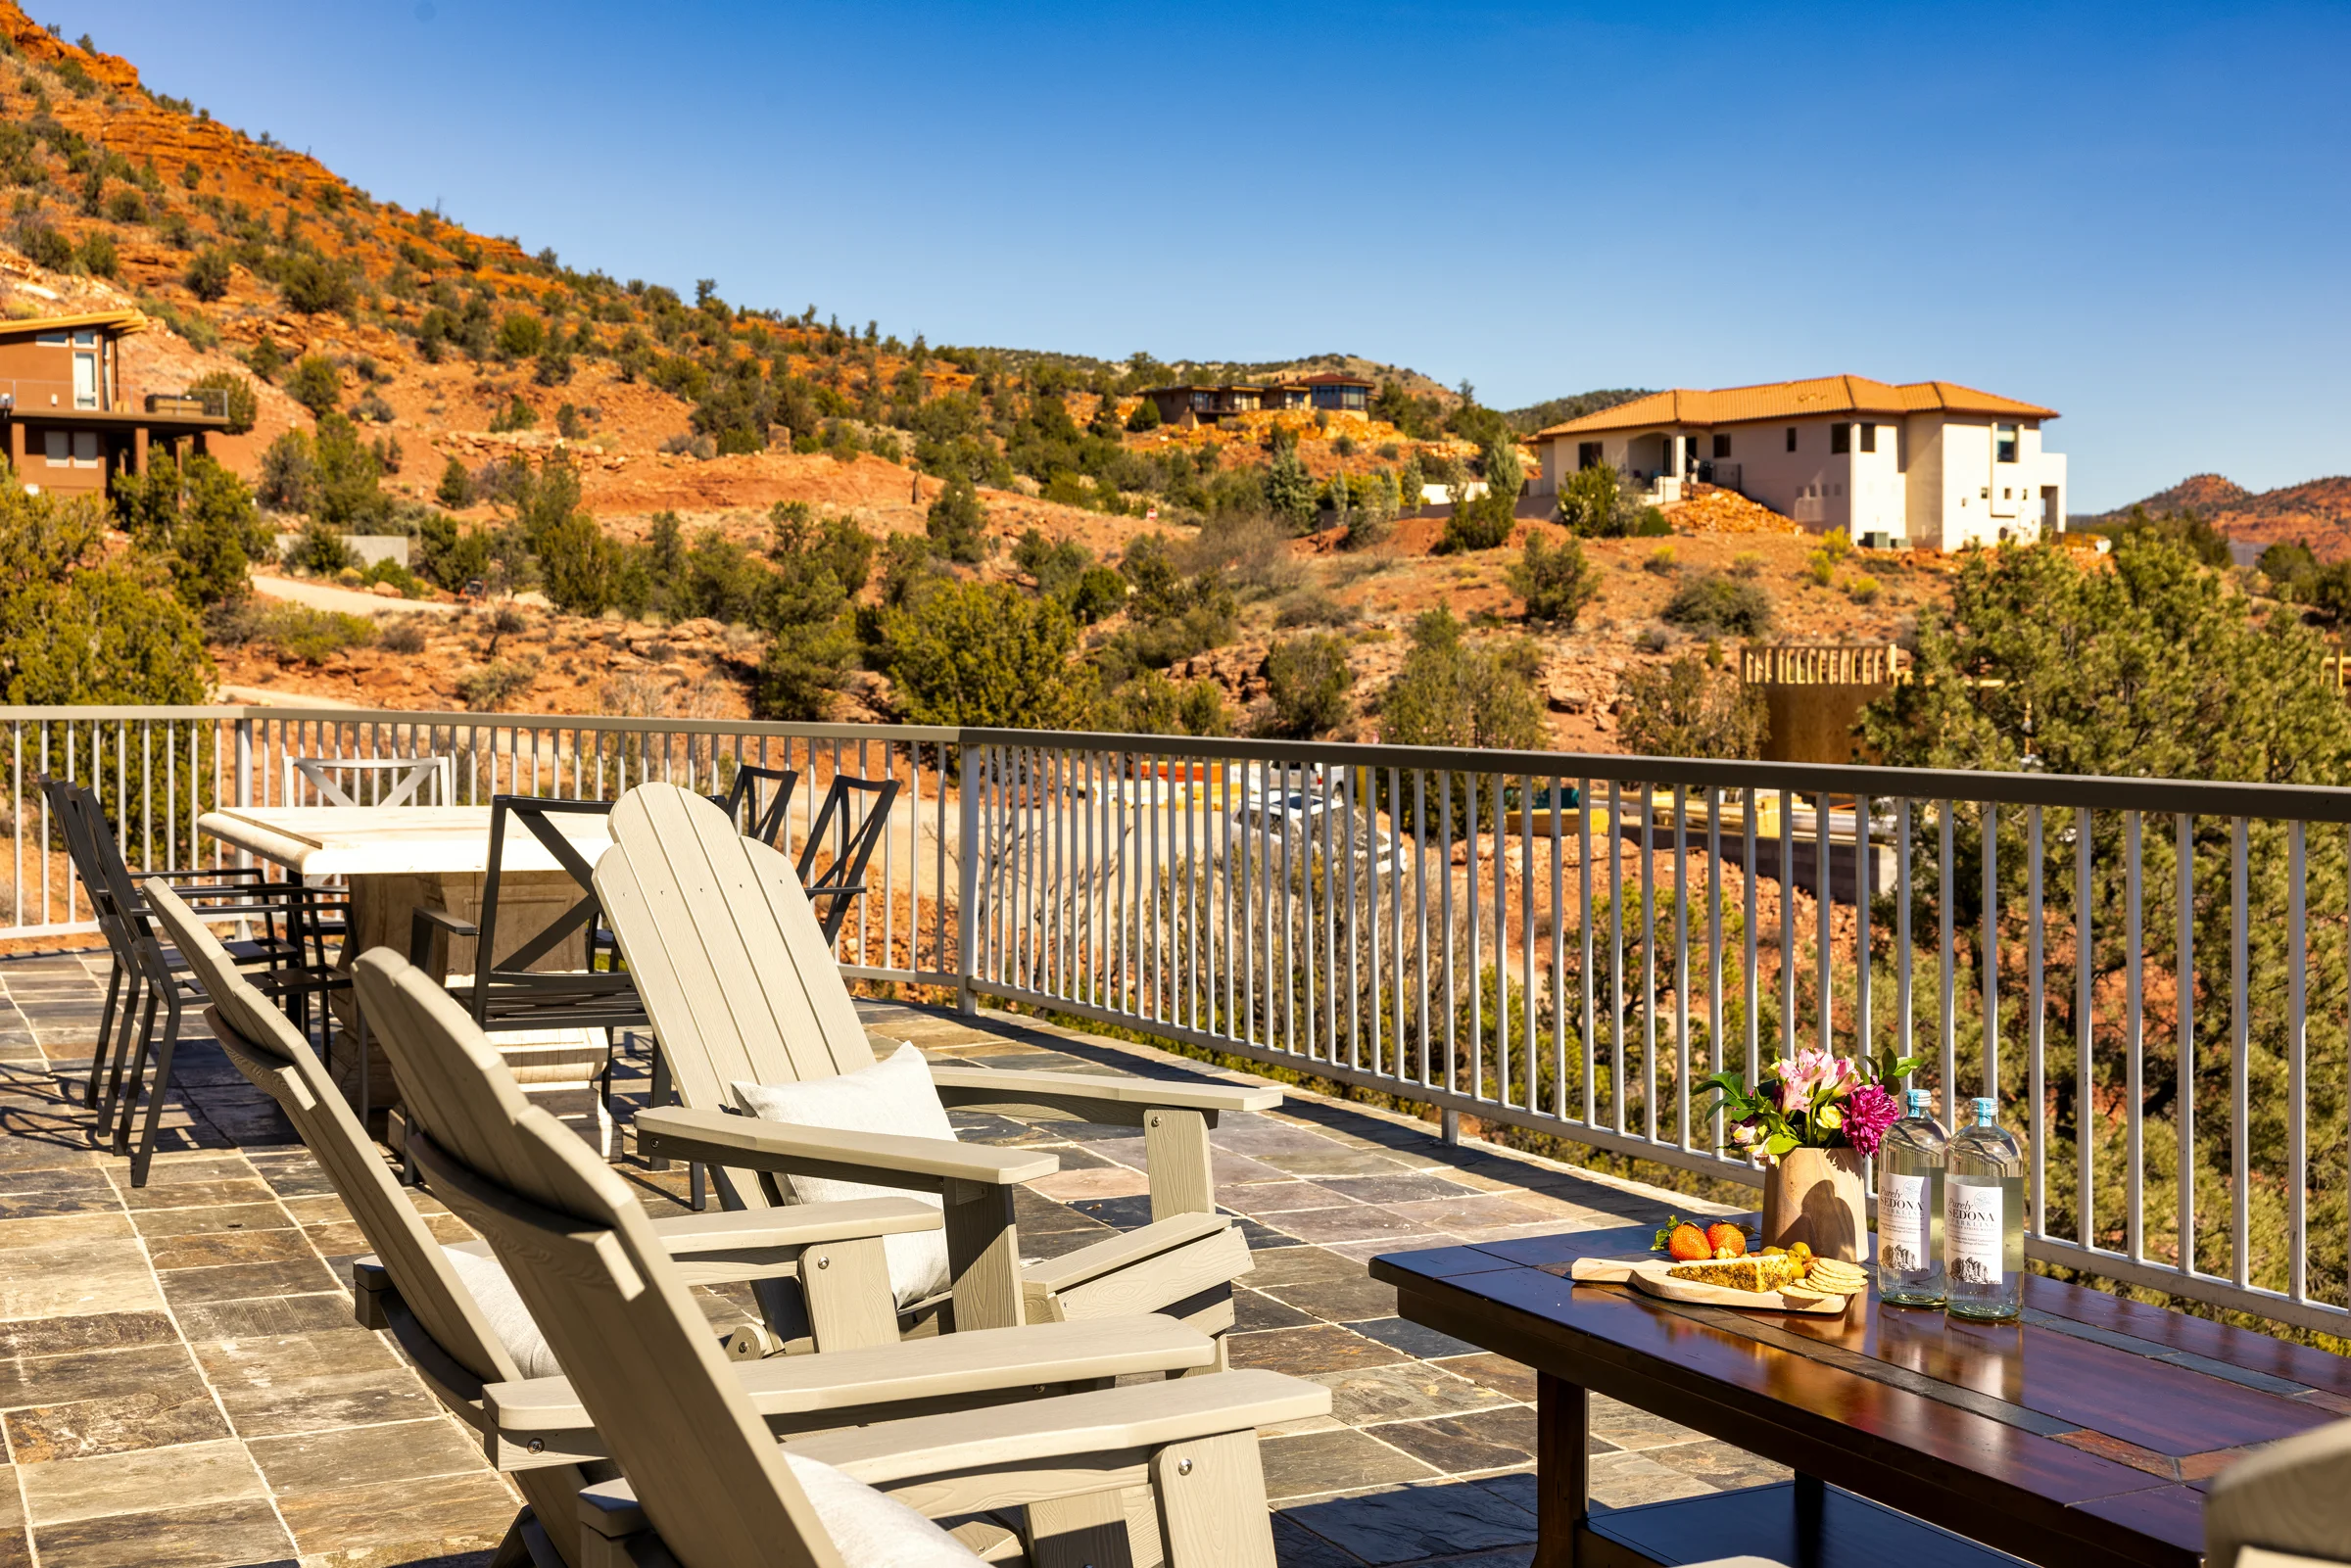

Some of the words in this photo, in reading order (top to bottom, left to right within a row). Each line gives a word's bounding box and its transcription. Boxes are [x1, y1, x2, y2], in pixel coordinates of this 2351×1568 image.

[1880, 1185, 1902, 1201] Purely
[1880, 1196, 1924, 1212] SEDONA
[1880, 1206, 1925, 1217] SPARKLING
[1948, 1197, 1973, 1212] Purely
[1947, 1207, 1994, 1222] SEDONA
[1948, 1217, 1996, 1227] SPARKLING
